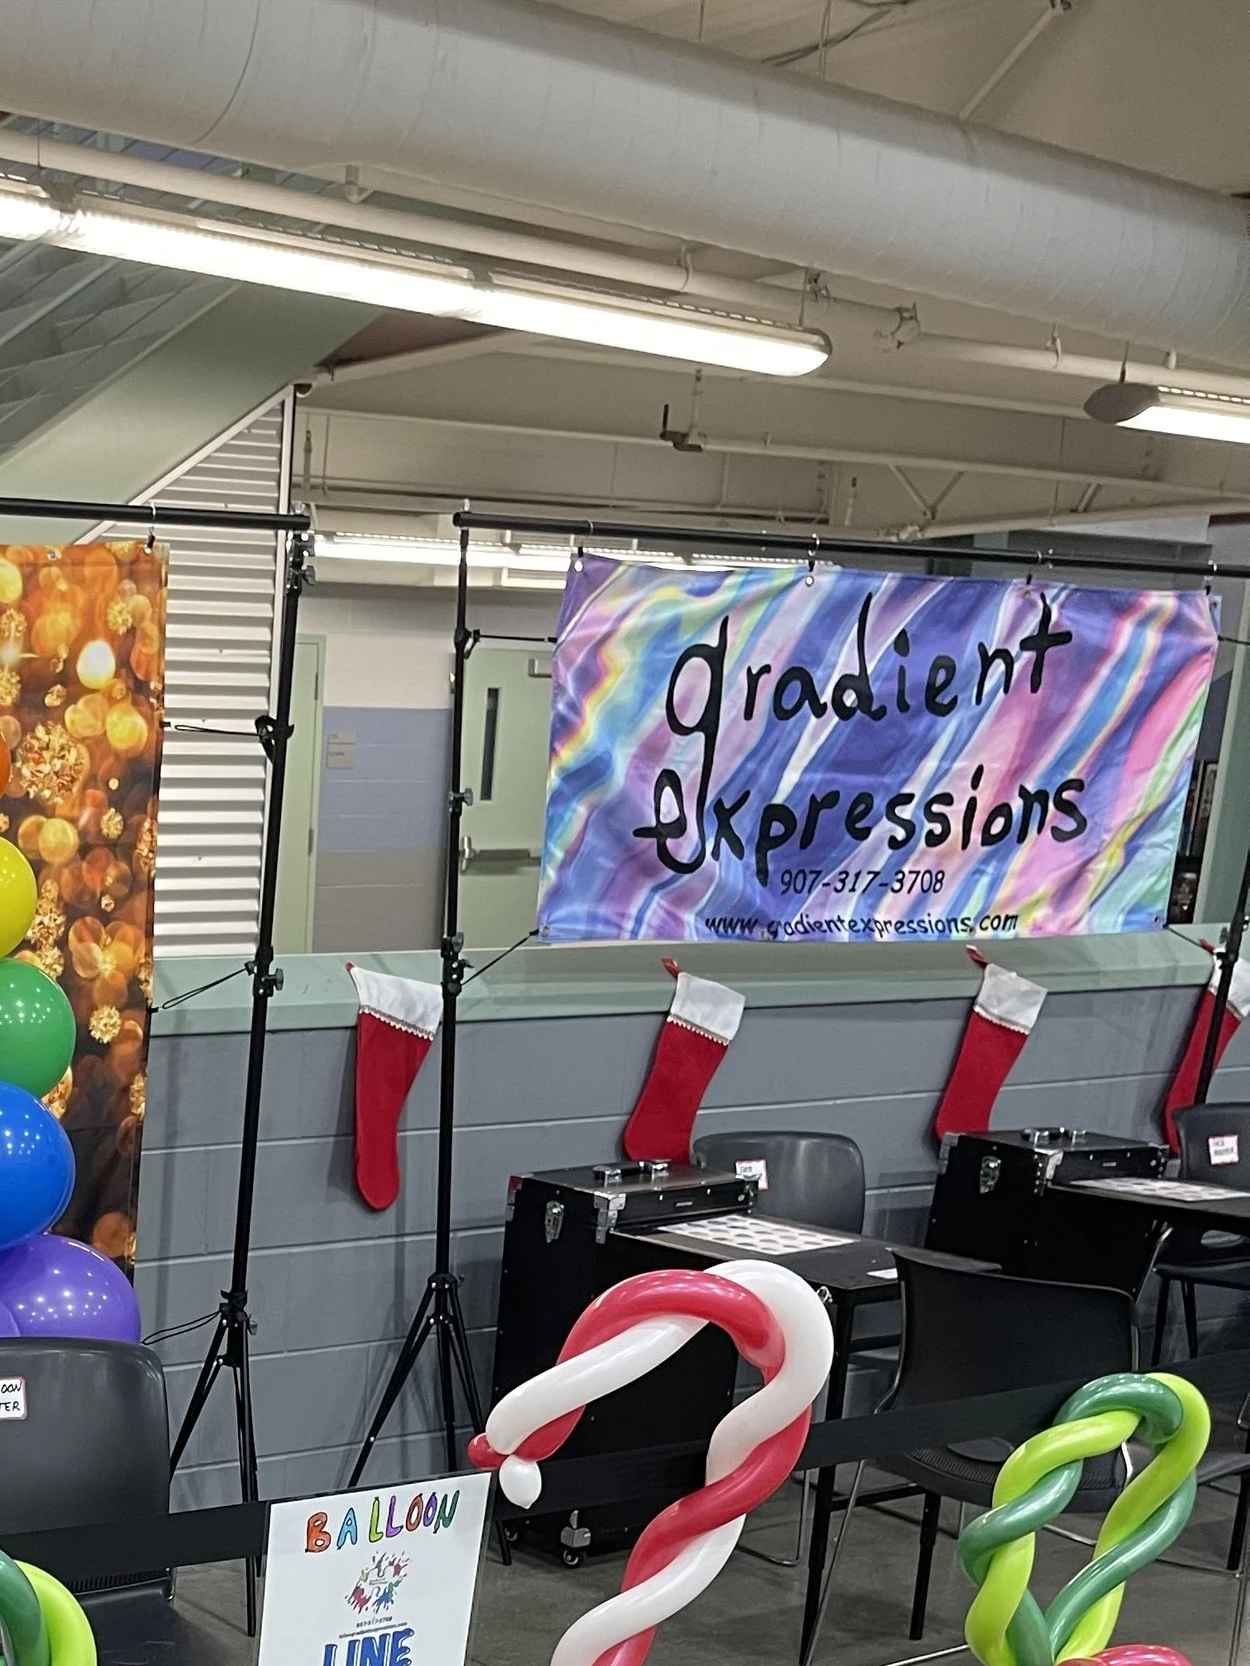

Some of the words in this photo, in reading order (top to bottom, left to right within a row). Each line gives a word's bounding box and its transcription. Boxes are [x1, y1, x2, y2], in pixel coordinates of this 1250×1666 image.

[658, 592, 1074, 862] gradient
[633, 764, 1088, 886] expressions
[780, 869, 946, 895] 907-317-3708
[305, 1490, 460, 1553] BALLOON
